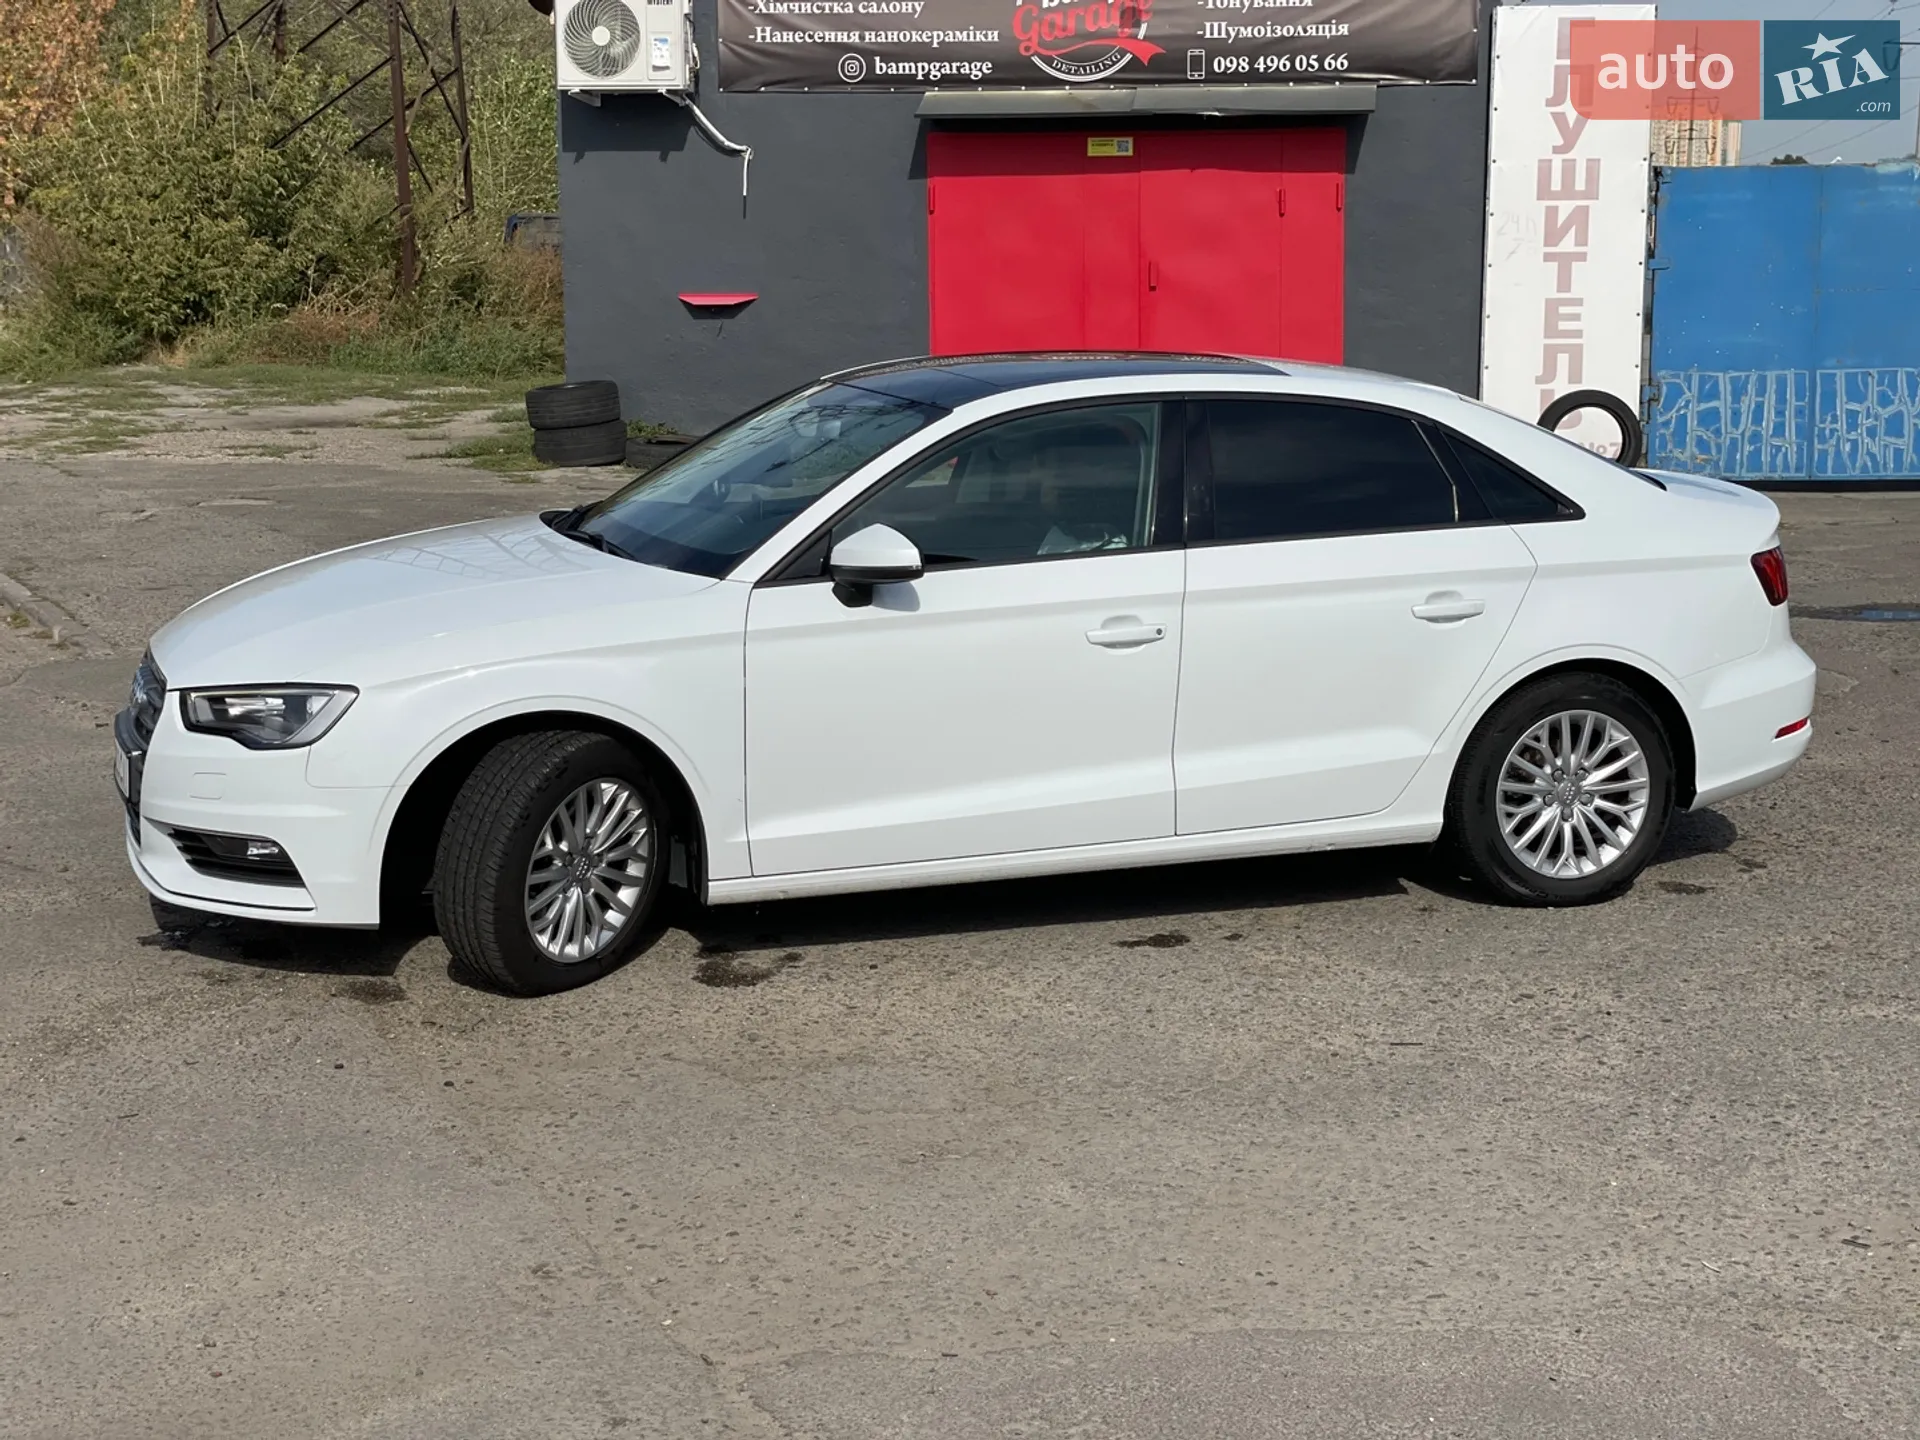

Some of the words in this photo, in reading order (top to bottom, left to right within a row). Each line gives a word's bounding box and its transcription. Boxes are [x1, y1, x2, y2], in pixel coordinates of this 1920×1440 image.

[858, 1, 926, 18] салону
[748, 26, 860, 43] -Нанесення
[864, 26, 1000, 47] нанокераміки
[1197, 19, 1349, 43] -Шумоізоляція
[874, 56, 993, 79] bampgarage
[1052, 52, 1121, 75] DETAILING
[1213, 55, 1250, 74] 098
[1254, 54, 1291, 73] 496
[1295, 54, 1319, 72] 05
[1324, 52, 1349, 71] 66
